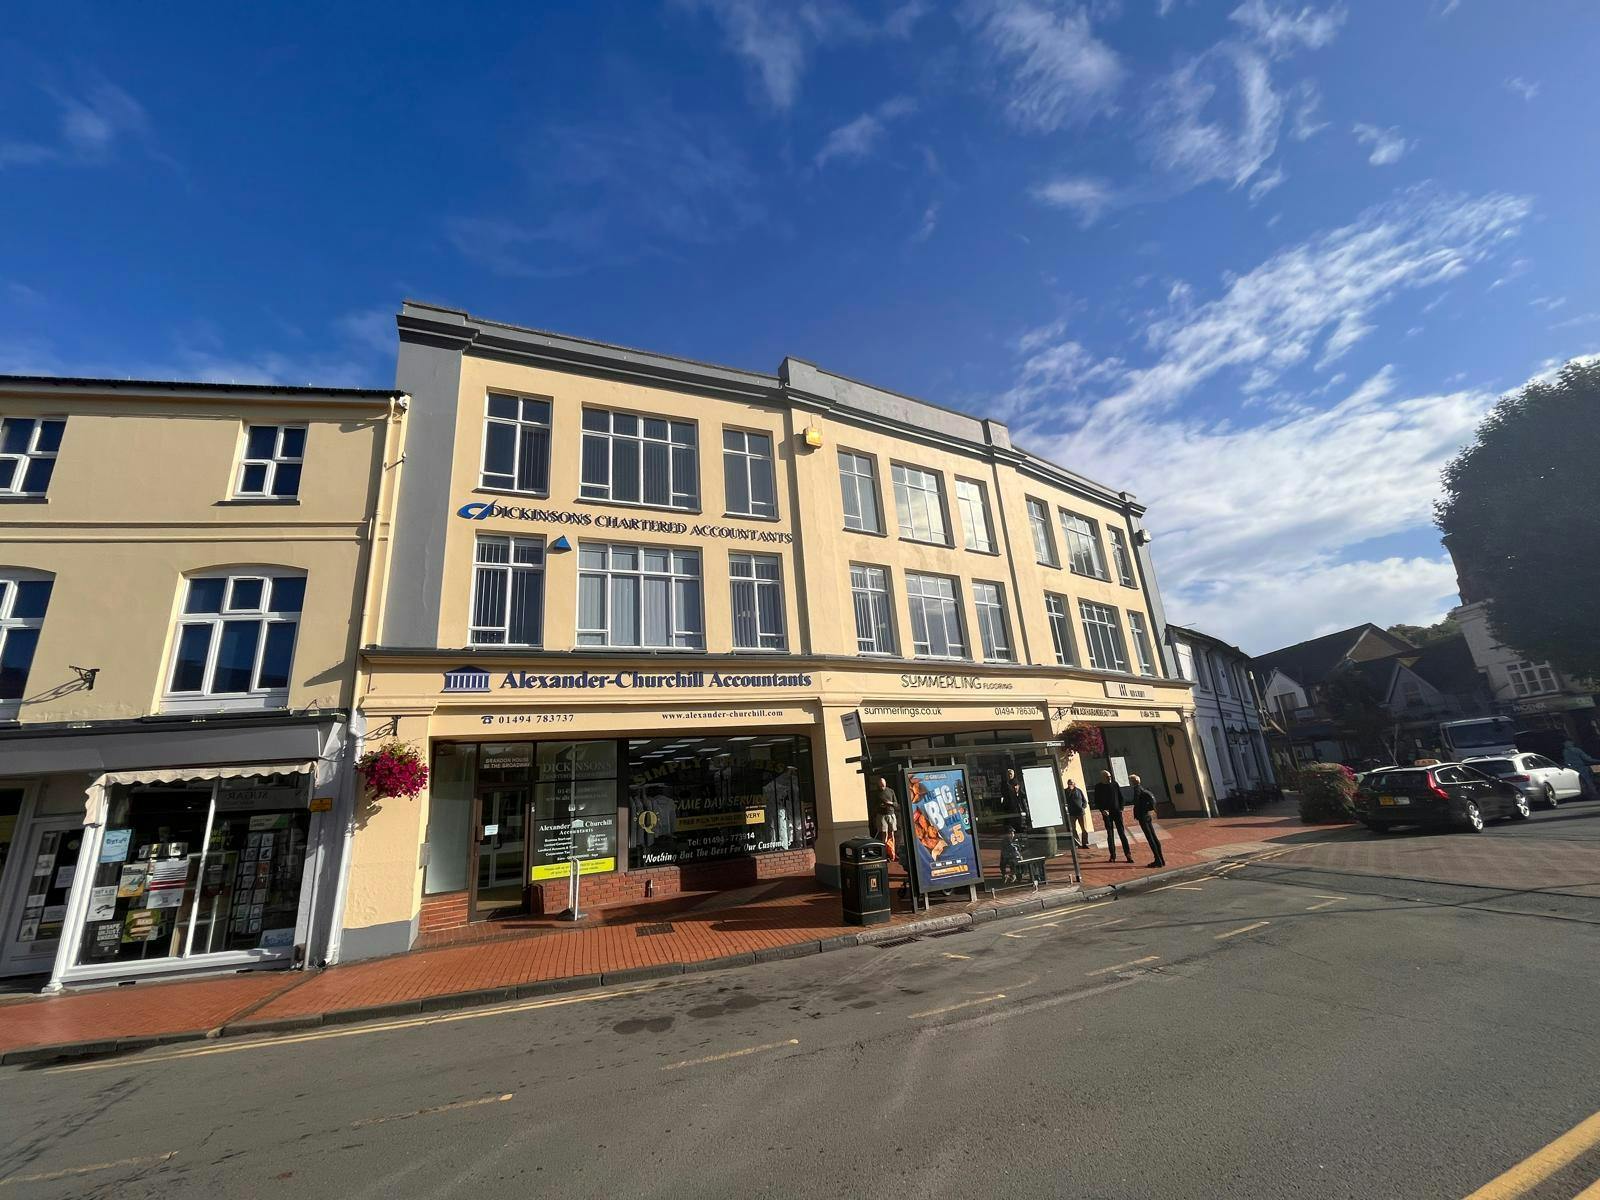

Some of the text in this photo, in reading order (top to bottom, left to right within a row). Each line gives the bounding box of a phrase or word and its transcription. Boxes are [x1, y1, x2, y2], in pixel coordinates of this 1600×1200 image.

[490, 505, 793, 544] DICKINSONS CHARTERED ACCOUNTANTS
[500, 671, 812, 689] Alexander-Churchill Accountants
[901, 674, 1013, 690] SUMMERLING FLOORING
[661, 709, 783, 719] www.alexander-churchill.com
[864, 707, 942, 717] summerlings.co.uk
[995, 707, 1014, 715] 01494
[498, 714, 574, 724] 01494 783737
[543, 760, 612, 774] DICKNSONS
[673, 798, 702, 810] SAME
[704, 797, 725, 809] DAY
[539, 819, 613, 832] Alexander Churchill
[758, 840, 792, 850] Customes
